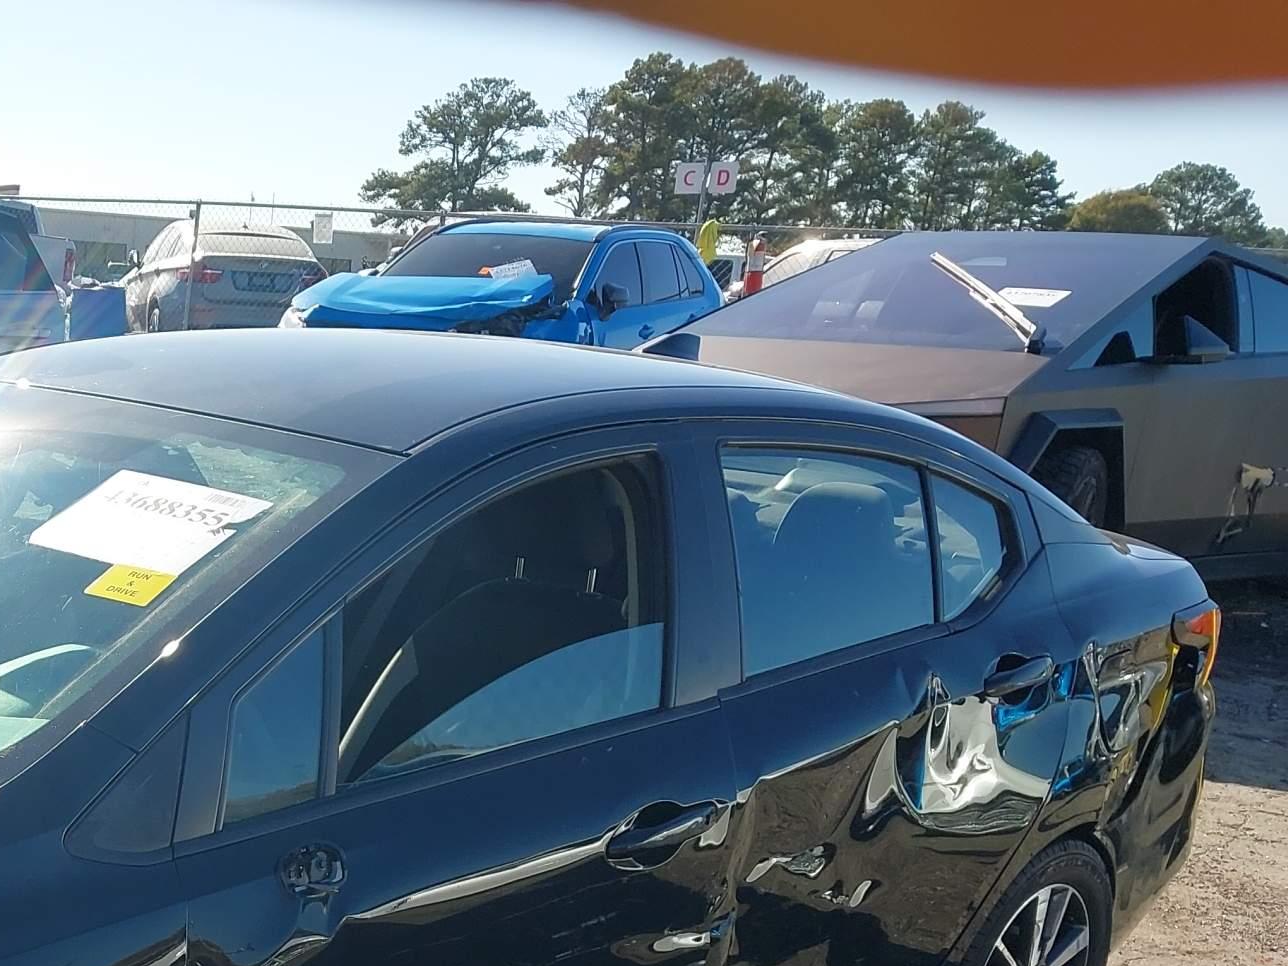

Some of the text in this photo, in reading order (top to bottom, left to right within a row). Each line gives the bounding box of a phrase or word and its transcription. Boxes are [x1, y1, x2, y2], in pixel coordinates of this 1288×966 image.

[684, 170, 696, 186] C
[717, 170, 730, 186] D
[127, 570, 153, 581] RUN
[105, 585, 139, 598] DRIVE
